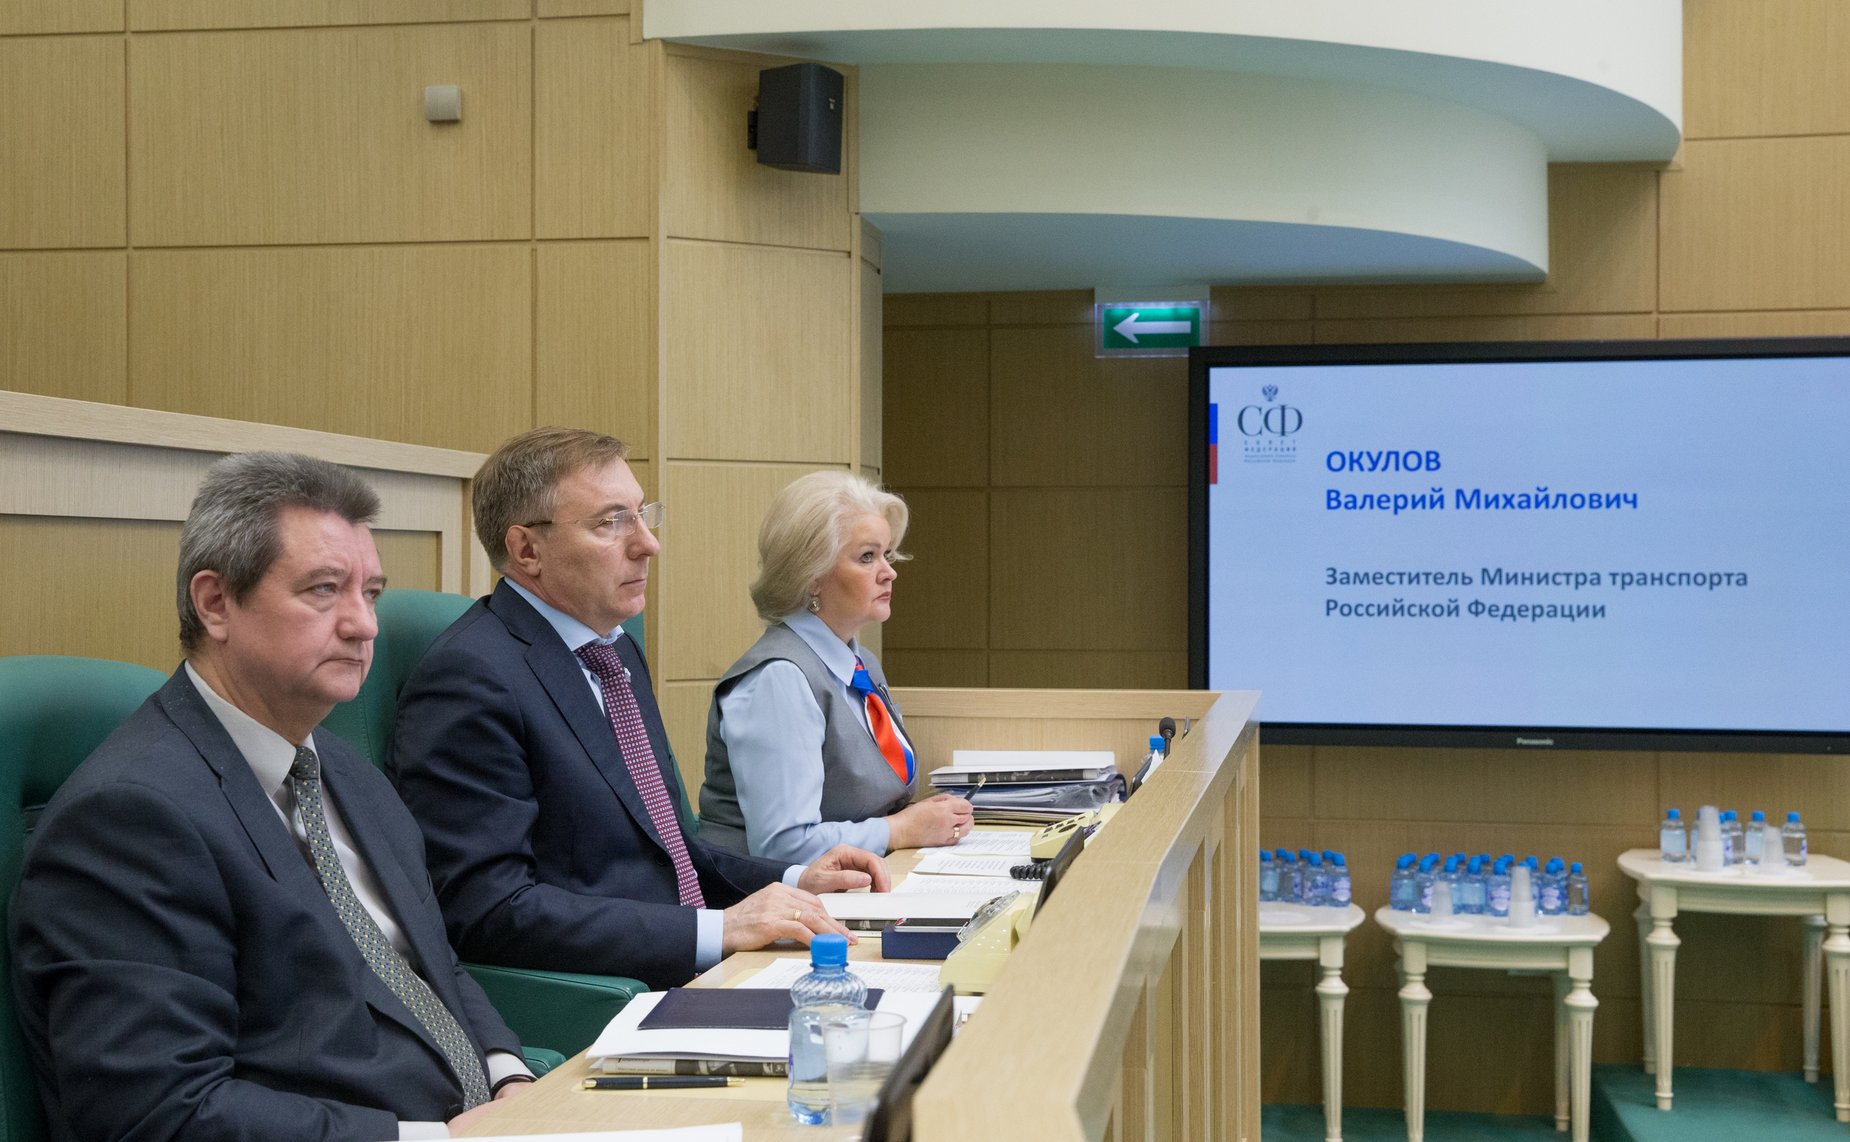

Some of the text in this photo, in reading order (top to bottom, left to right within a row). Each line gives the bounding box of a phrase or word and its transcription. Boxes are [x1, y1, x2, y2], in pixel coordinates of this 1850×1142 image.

[1237, 405, 1303, 438] СФ
[1326, 450, 1441, 473] ОКУЛОВ
[1326, 486, 1638, 515] Валерий Михайлович
[1326, 567, 1749, 592] Заместитель Министра транспорта
[1326, 597, 1606, 623] Российской Федерации
